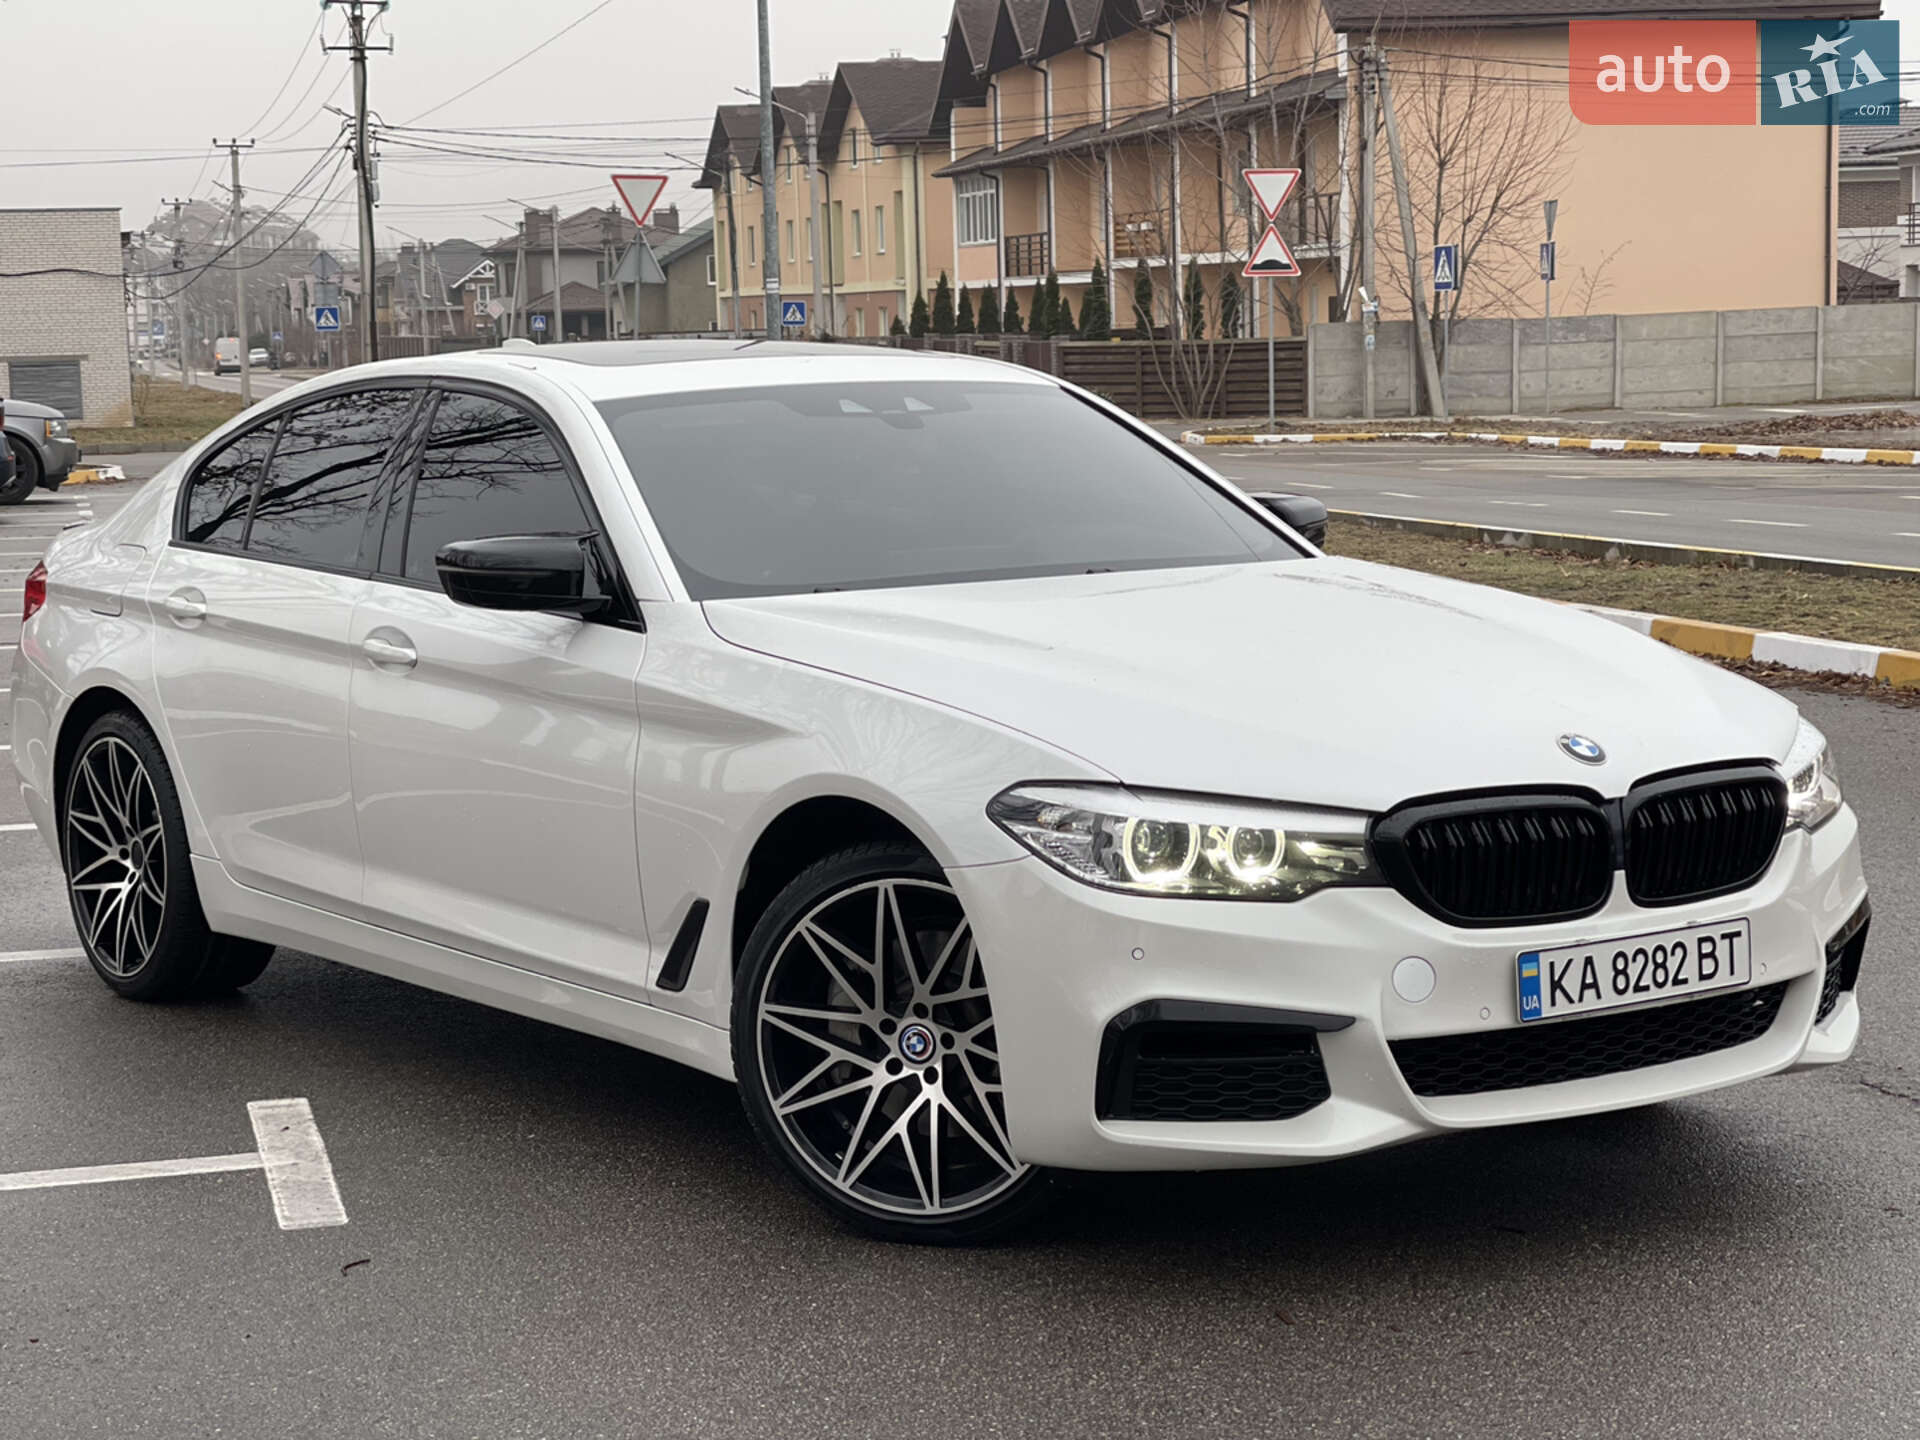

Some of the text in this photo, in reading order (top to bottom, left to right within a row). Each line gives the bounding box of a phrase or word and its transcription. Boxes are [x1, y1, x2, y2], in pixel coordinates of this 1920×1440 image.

[1549, 930, 1742, 1007] KA 8282 BT
[1522, 995, 1540, 1011] UA
